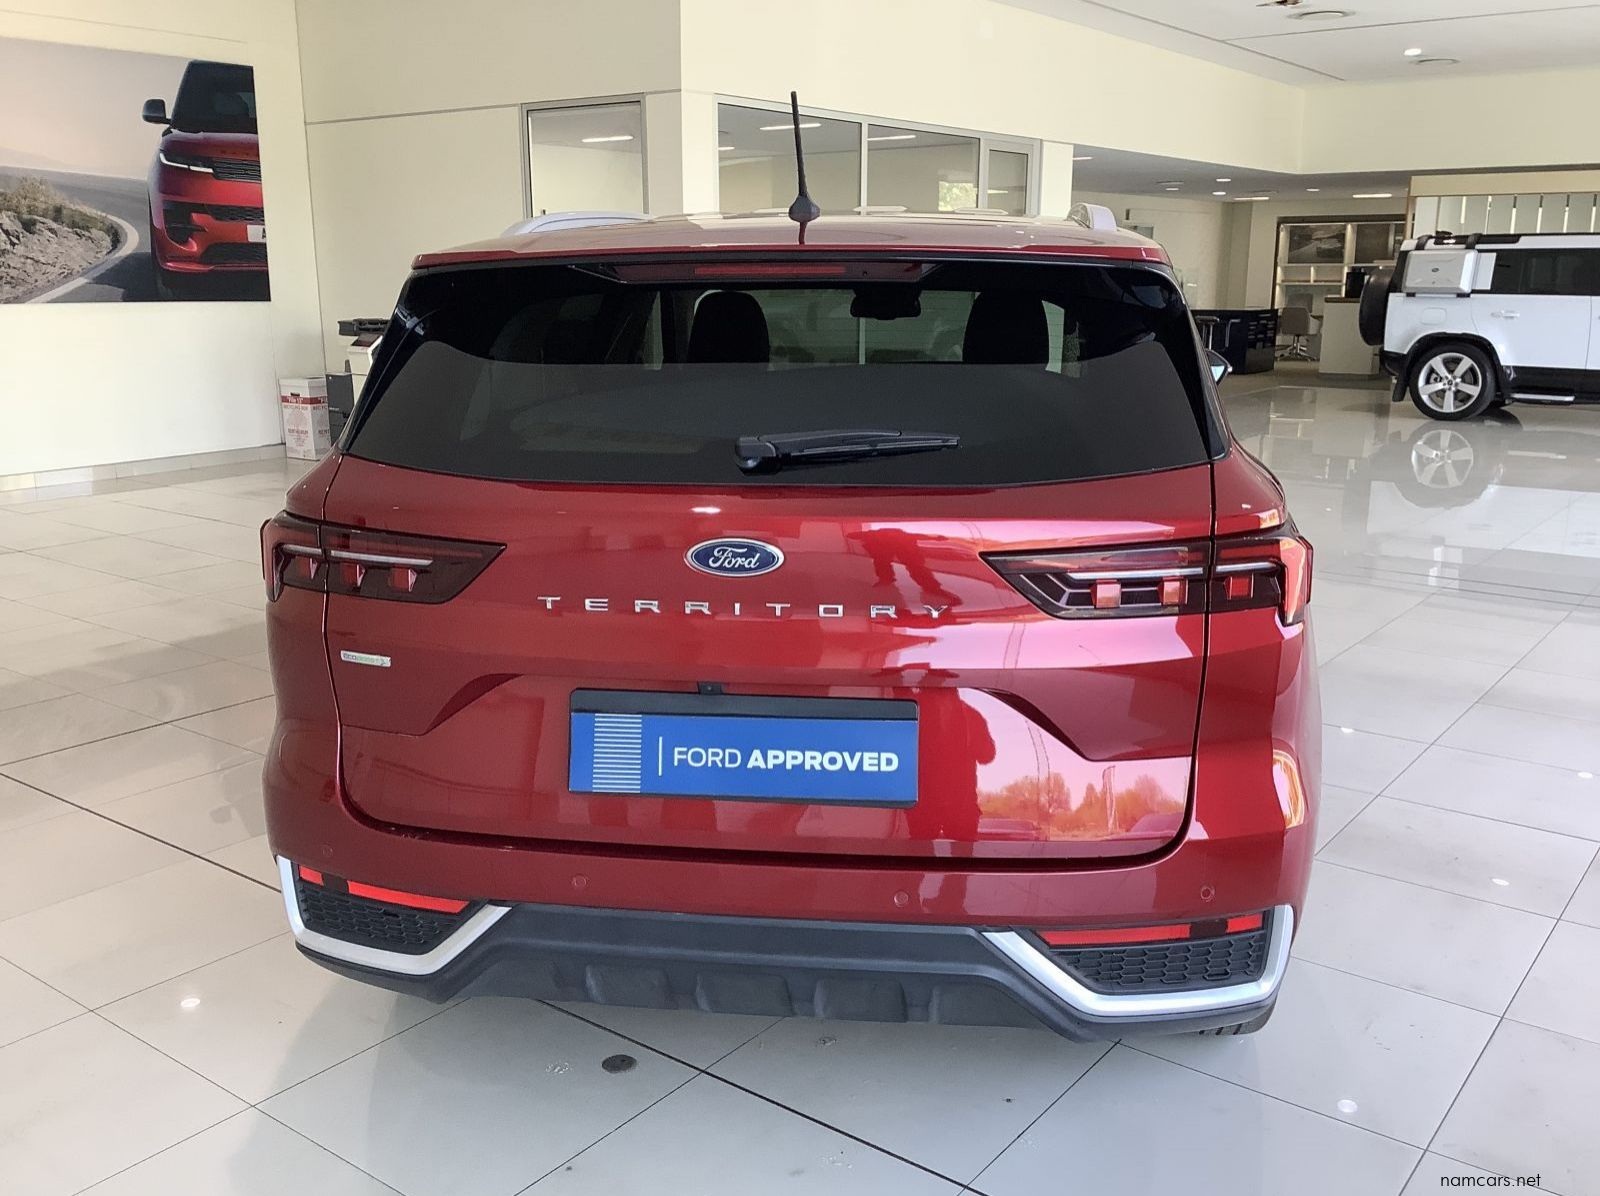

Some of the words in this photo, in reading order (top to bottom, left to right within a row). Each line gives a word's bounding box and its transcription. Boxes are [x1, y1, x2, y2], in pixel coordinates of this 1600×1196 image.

[708, 546, 761, 569] Ford
[537, 596, 949, 619] TERRITORY
[673, 747, 742, 768] FORD
[747, 749, 899, 772] APPROVED
